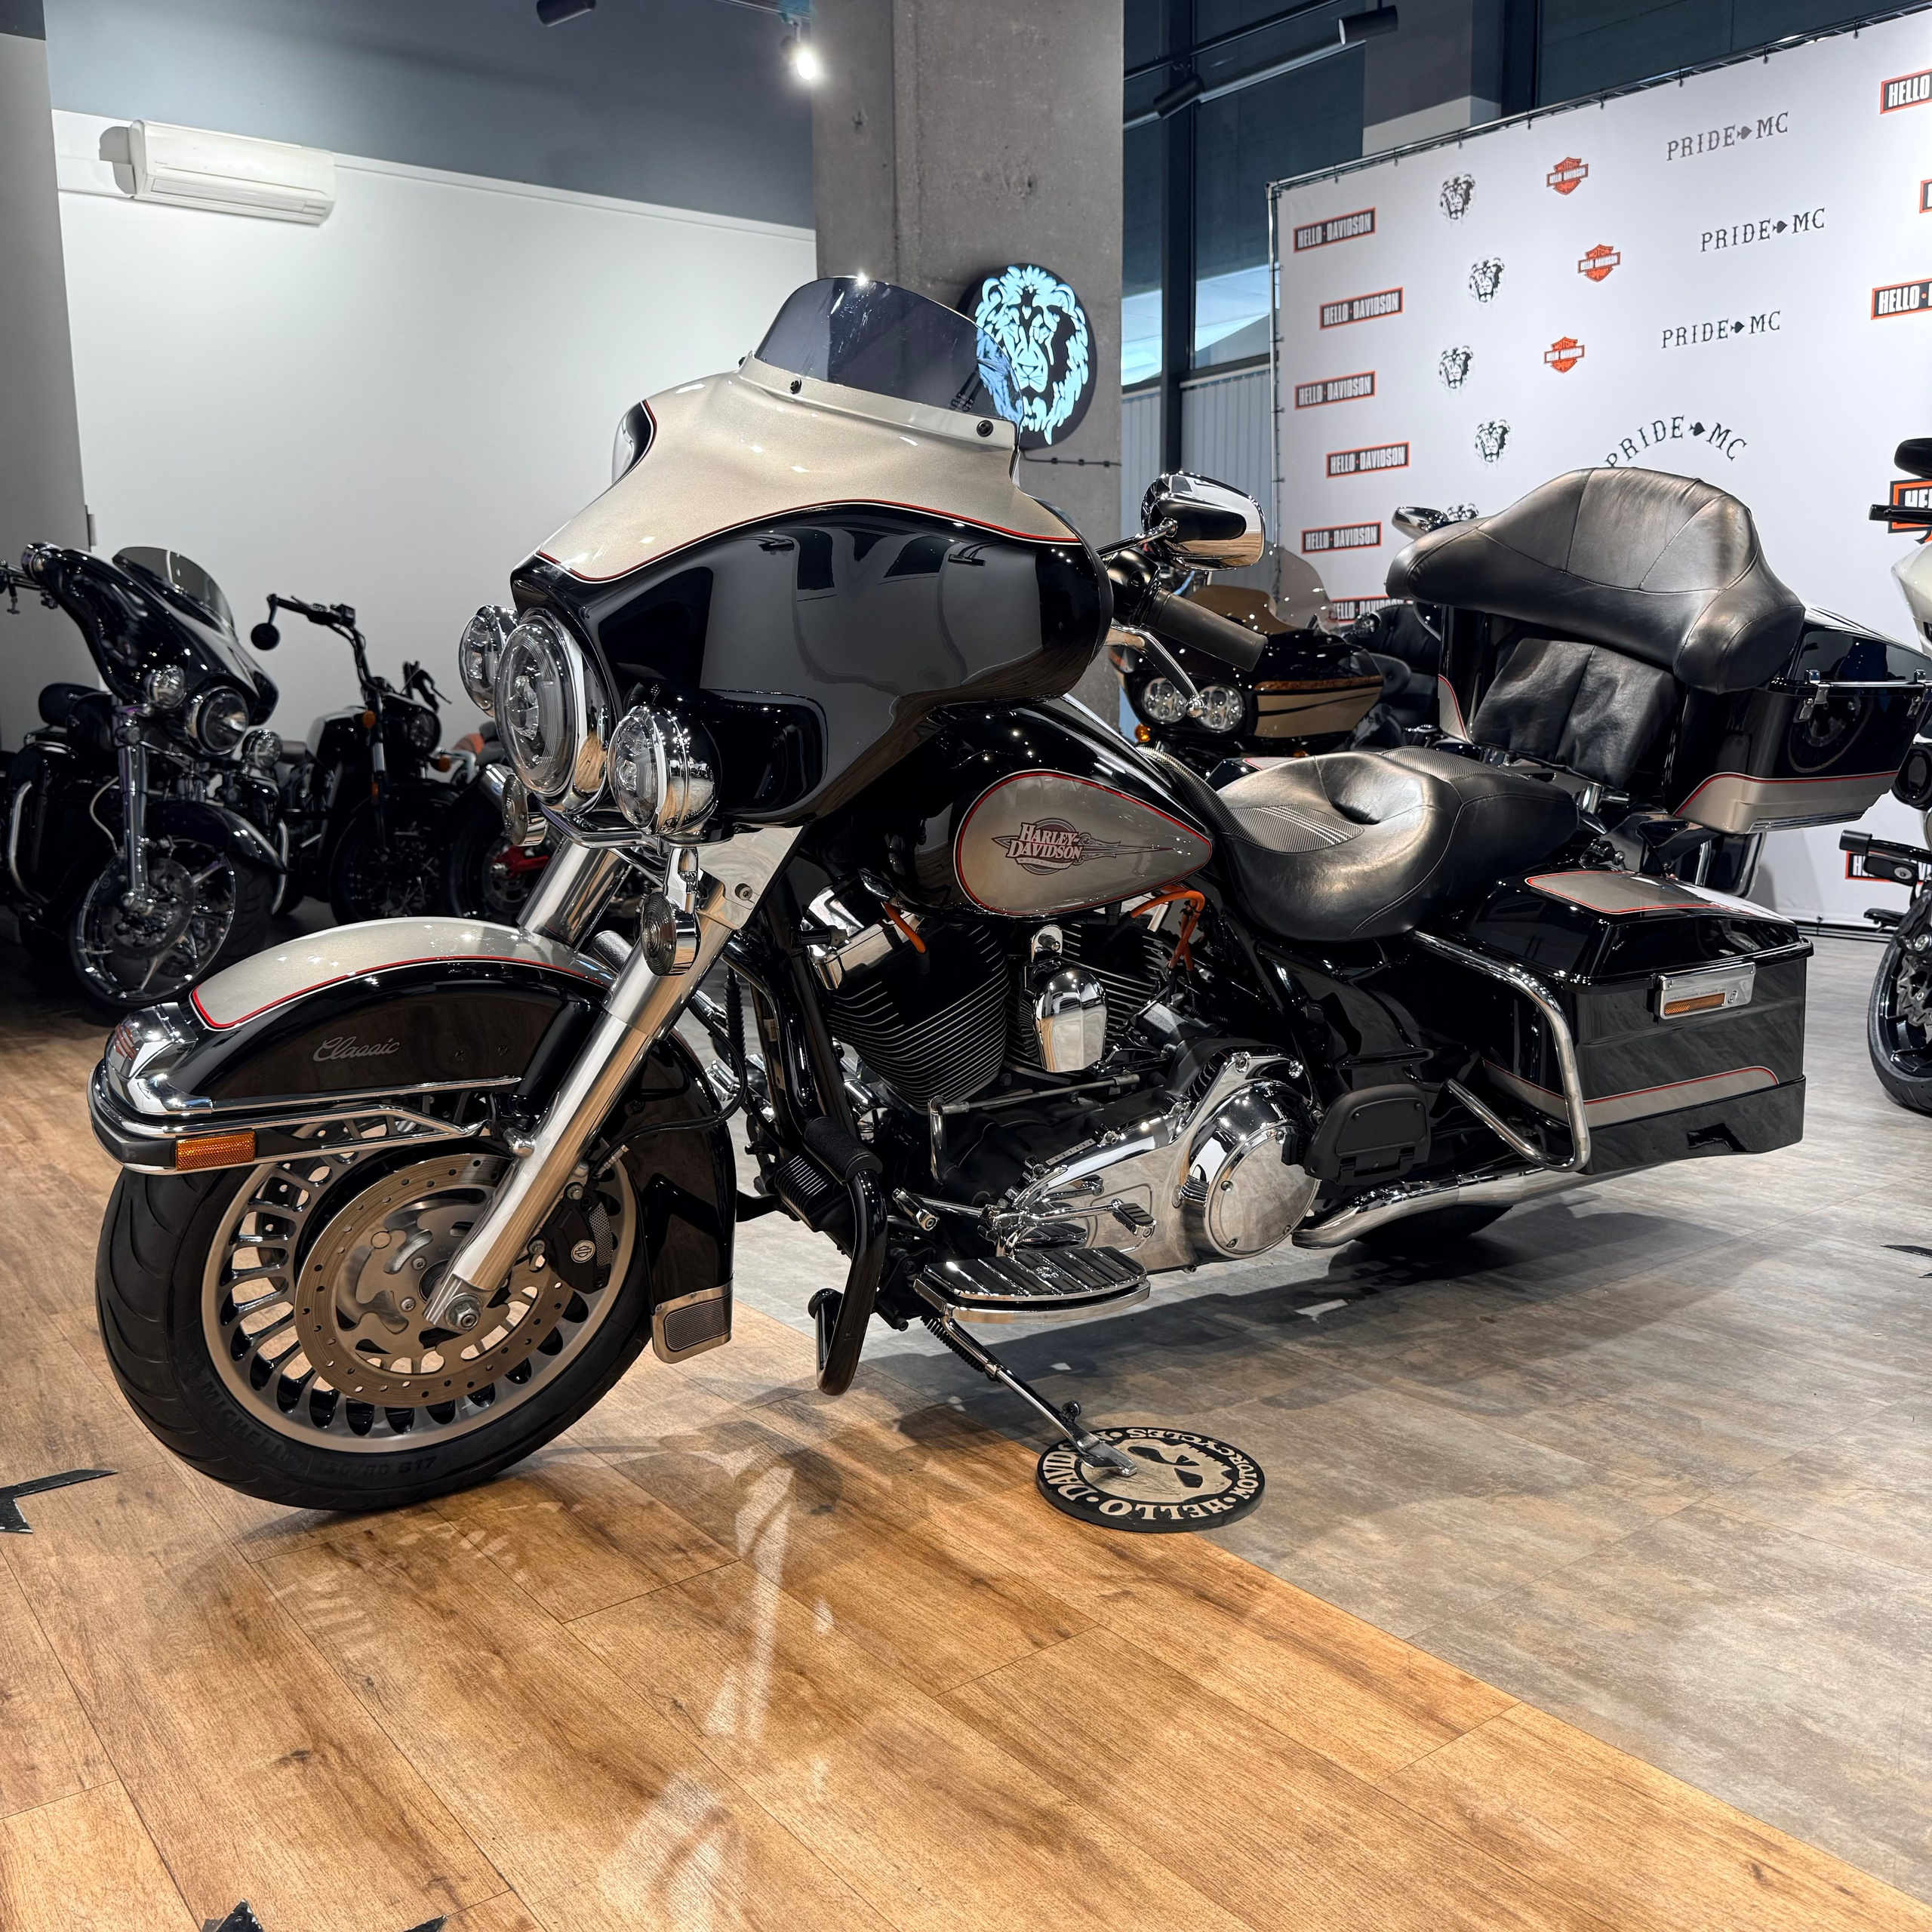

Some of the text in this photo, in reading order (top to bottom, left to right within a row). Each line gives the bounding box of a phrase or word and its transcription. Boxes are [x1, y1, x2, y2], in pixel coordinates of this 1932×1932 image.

[1888, 75, 1930, 108] HELLO
[1666, 111, 1789, 162] PRIDE MC
[1297, 213, 1372, 249] HELLO DAVIDSON
[1700, 208, 1825, 252] PRIDE MC
[1324, 292, 1399, 326] HELLO DAVIDSON
[1878, 285, 1920, 315] HELLO
[1661, 310, 1780, 349] PRIDE MC
[1298, 375, 1372, 406] HELLO DAVIDSON
[1604, 414, 1747, 467] PRIDE MC
[1331, 445, 1405, 475] HELLO DAVIDSON
[1305, 525, 1378, 551] HELLO DAVIDSON
[1007, 839, 1083, 860] DAVIDSON
[1019, 823, 1081, 846] HARLEY-
[312, 1036, 400, 1062] Classic
[1126, 1428, 1259, 1500] MOTORCYCLES
[1098, 1498, 1235, 1520] HELLO
